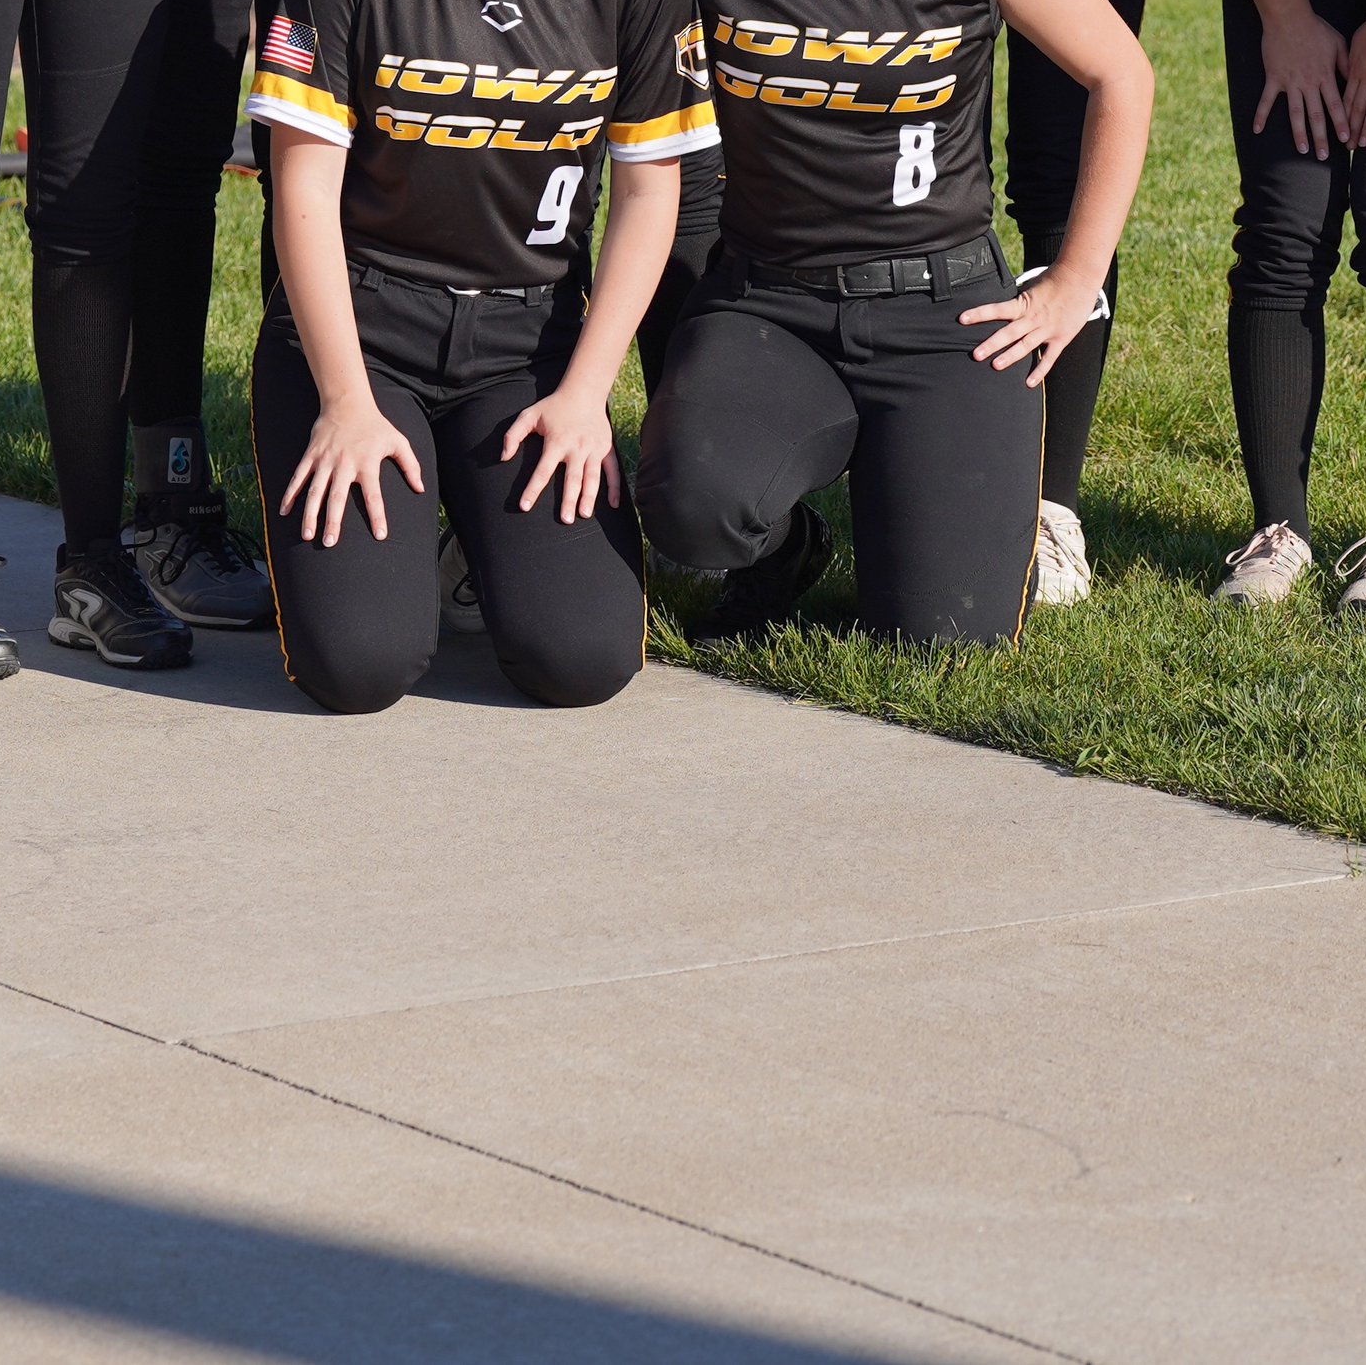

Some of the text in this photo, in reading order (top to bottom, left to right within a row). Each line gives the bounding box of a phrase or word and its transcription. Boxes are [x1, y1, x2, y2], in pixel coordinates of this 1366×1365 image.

[713, 13, 963, 67] IOWA
[375, 54, 618, 105] IOWA
[714, 60, 958, 114] GOLD
[375, 106, 605, 152] GOLD
[892, 121, 937, 208] 8
[525, 165, 584, 245] 9
